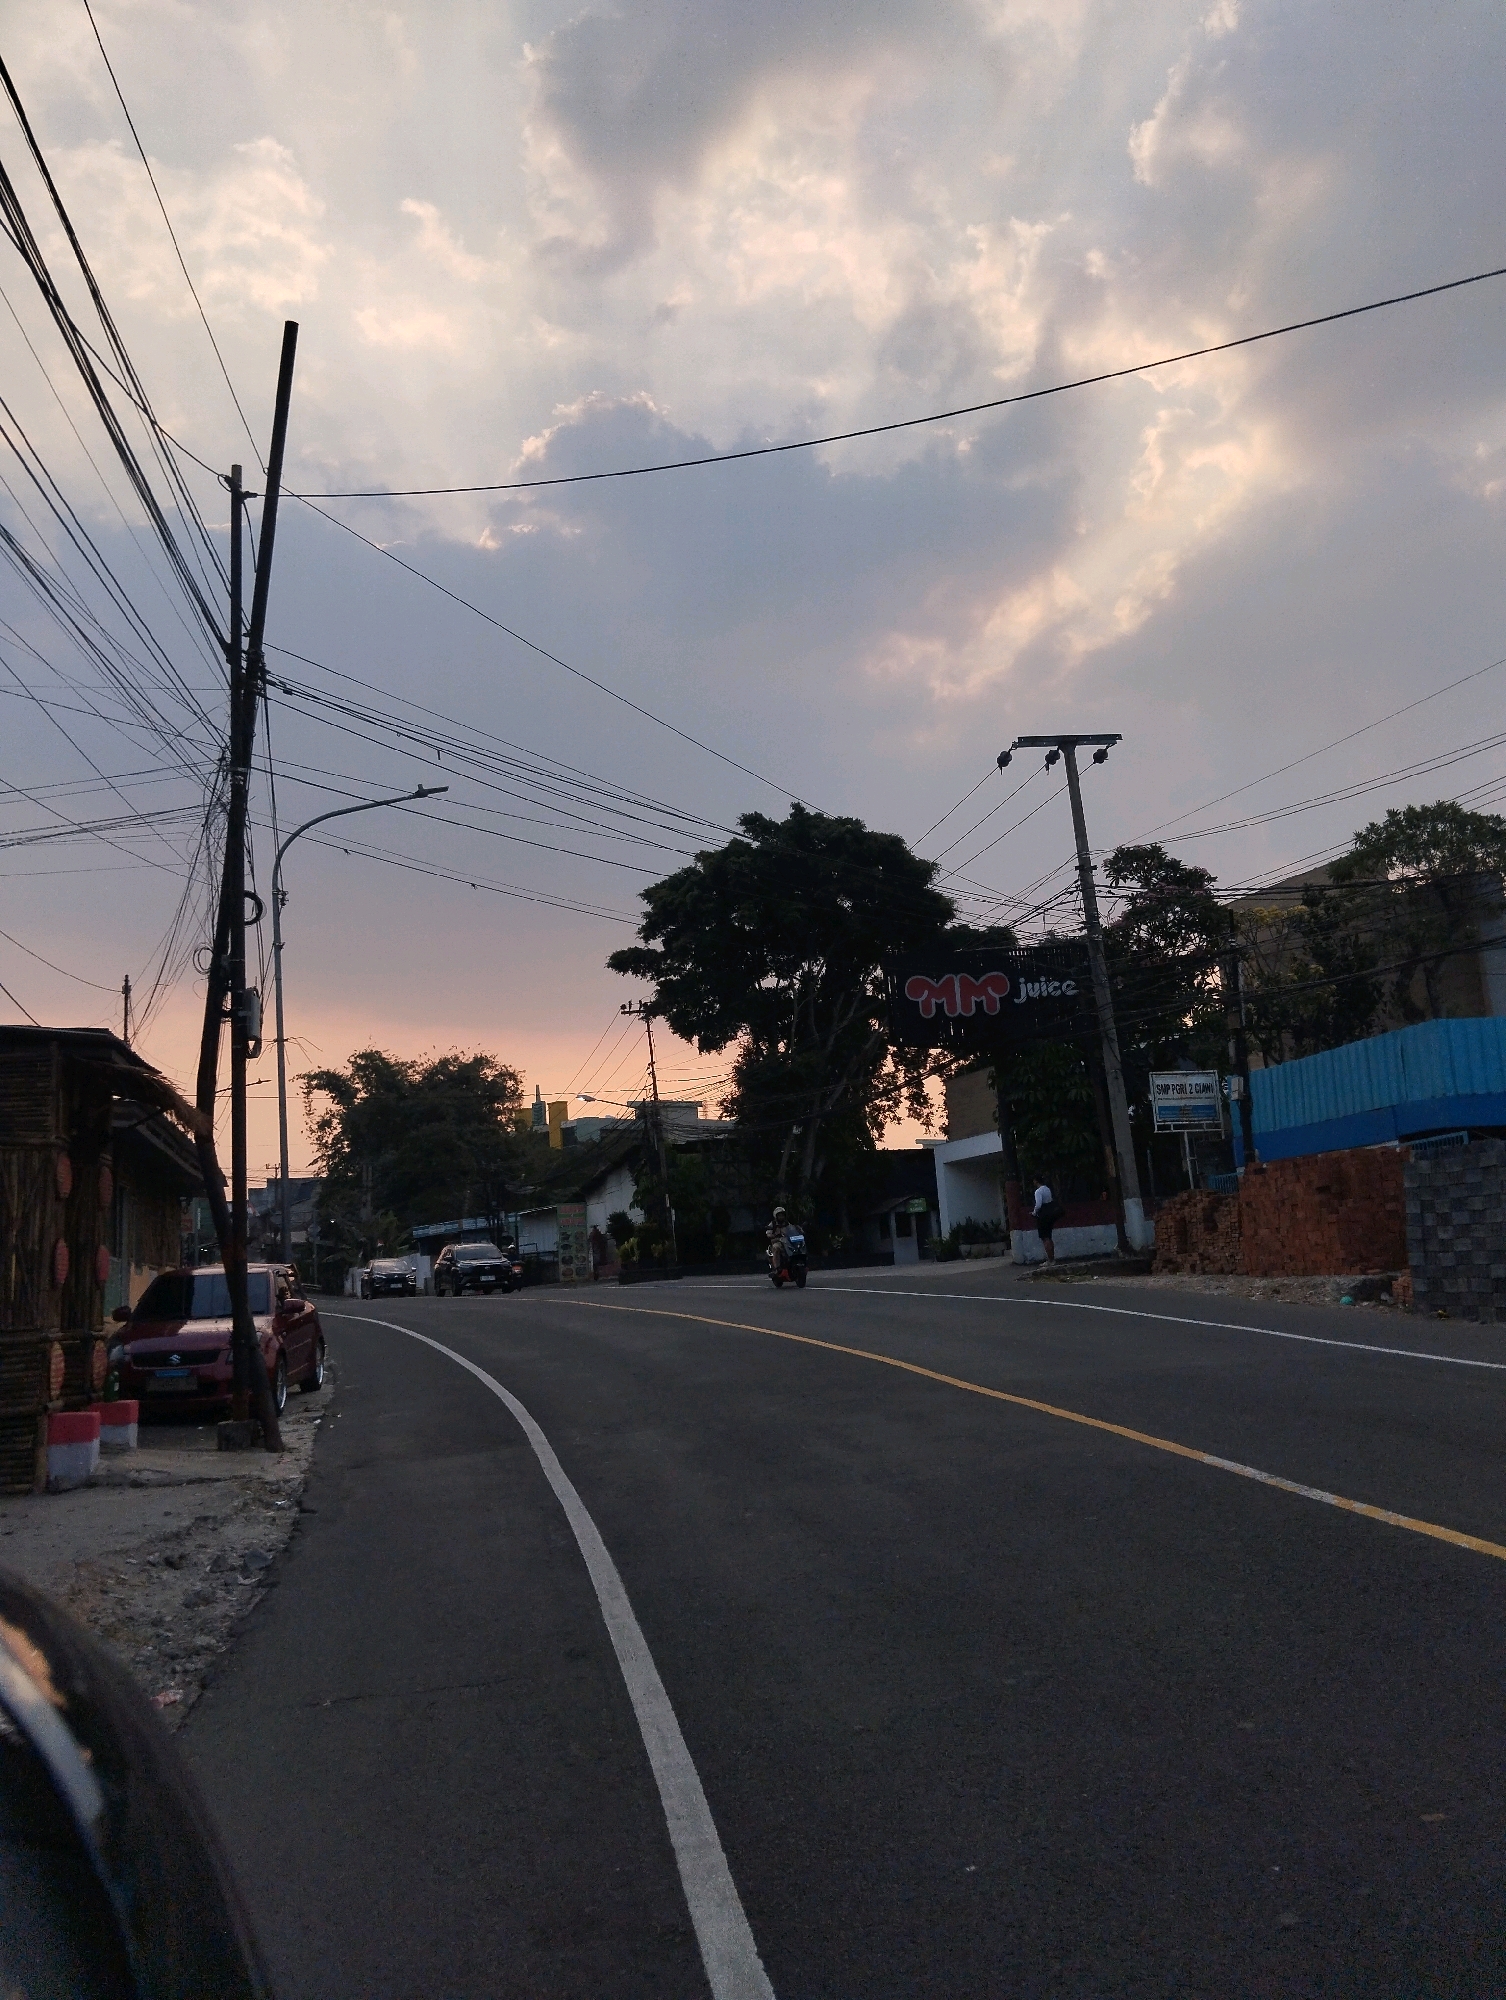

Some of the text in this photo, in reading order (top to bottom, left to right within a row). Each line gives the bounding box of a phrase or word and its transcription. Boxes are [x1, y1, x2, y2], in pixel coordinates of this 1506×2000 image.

[905, 971, 1080, 1019] MM juice
[1171, 1083, 1188, 1095] PGRI
[1188, 1083, 1193, 1094] 2
